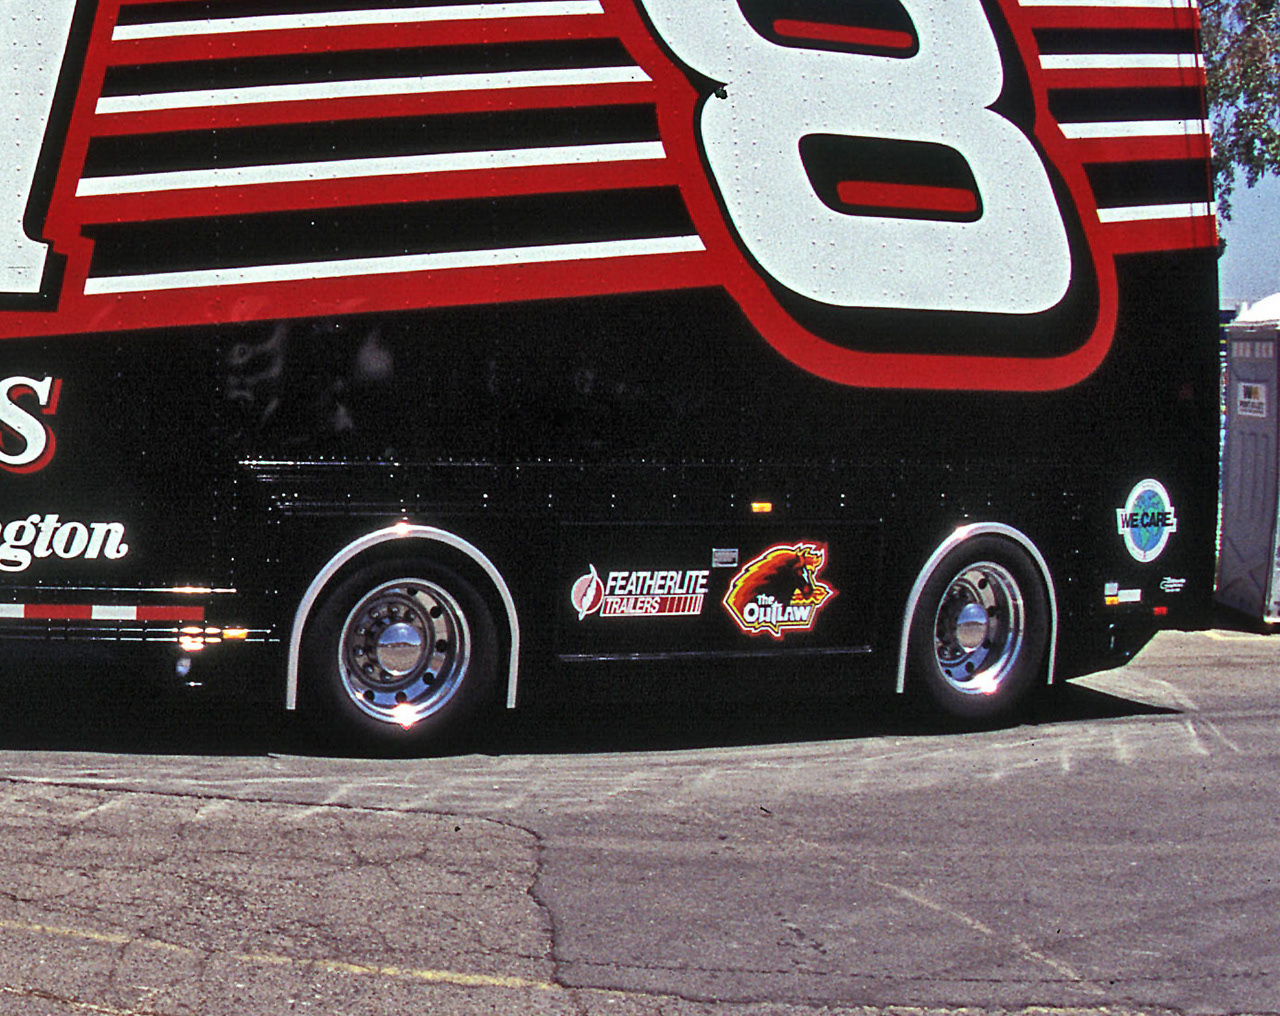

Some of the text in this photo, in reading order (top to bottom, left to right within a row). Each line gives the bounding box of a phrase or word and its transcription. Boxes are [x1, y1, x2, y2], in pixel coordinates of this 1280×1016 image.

[1120, 513, 1139, 528] WE
[605, 570, 710, 595] FEATHERLITE
[605, 596, 660, 614] TRAILERS
